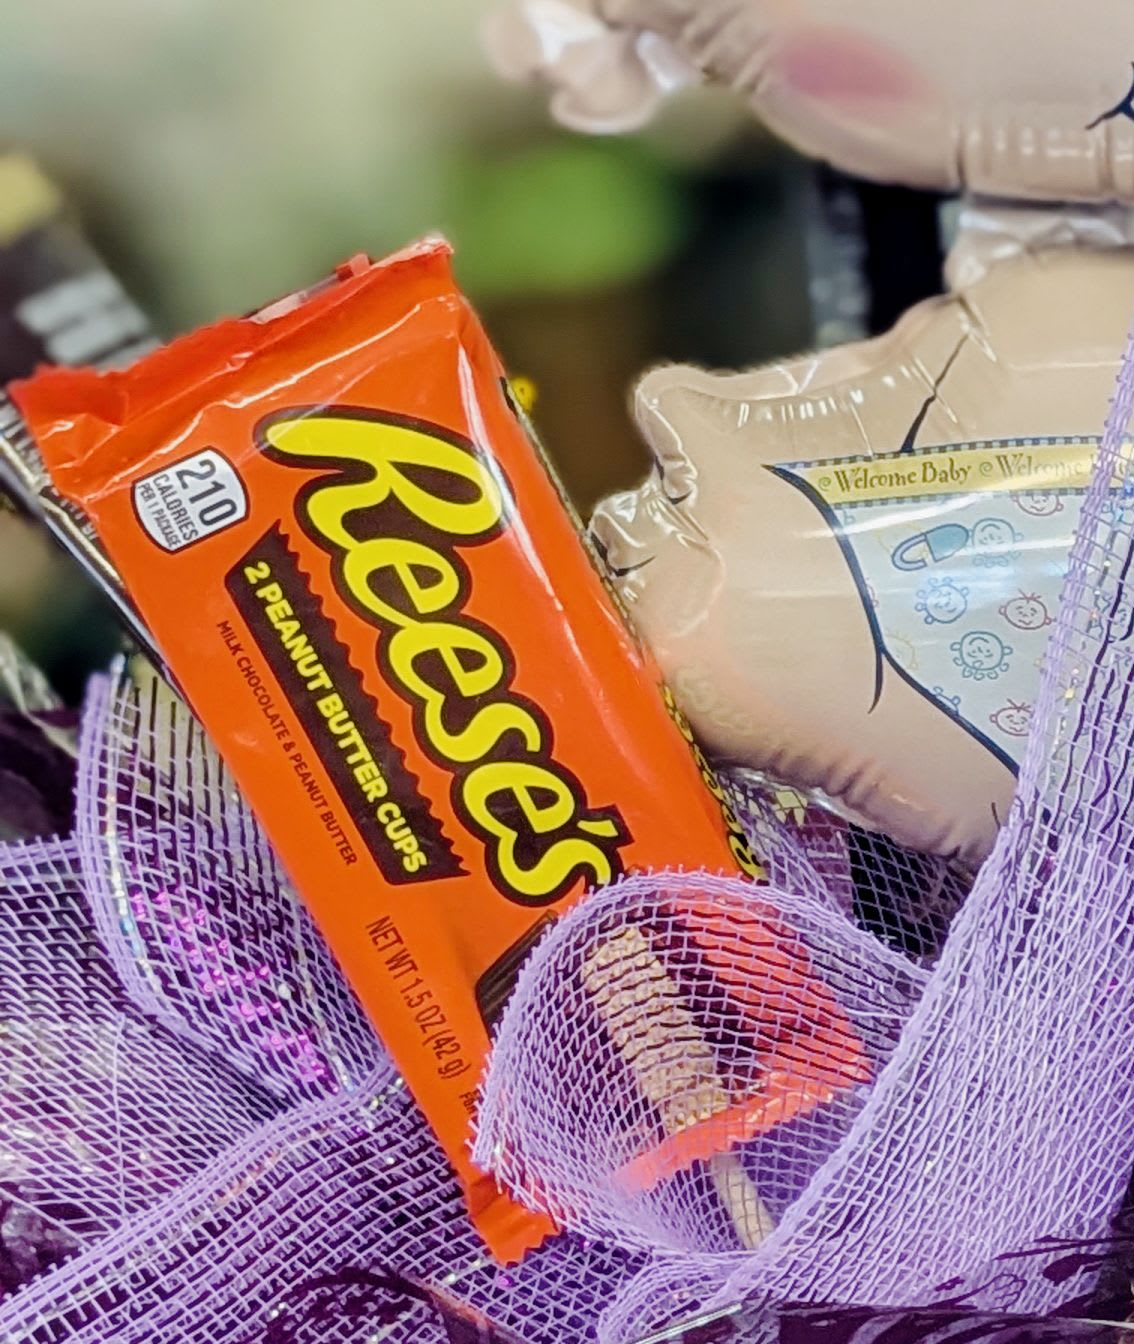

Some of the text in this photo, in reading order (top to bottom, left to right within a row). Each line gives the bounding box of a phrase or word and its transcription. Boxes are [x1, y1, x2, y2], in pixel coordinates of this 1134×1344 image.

[138, 482, 181, 547] PER 1 PACKAGE
[153, 474, 198, 541] CALORIES
[176, 459, 237, 526] 210
[834, 465, 916, 493] Welcome
[922, 457, 972, 485] Baby
[265, 417, 617, 897] Reese's
[217, 620, 357, 866] MILK CHOCOLATE & PEANUT BUTTER
[244, 561, 428, 873] 2 PEANUT BUTTER CUPS
[365, 915, 472, 1080] NET WT 1.5 OZ (42 g)
